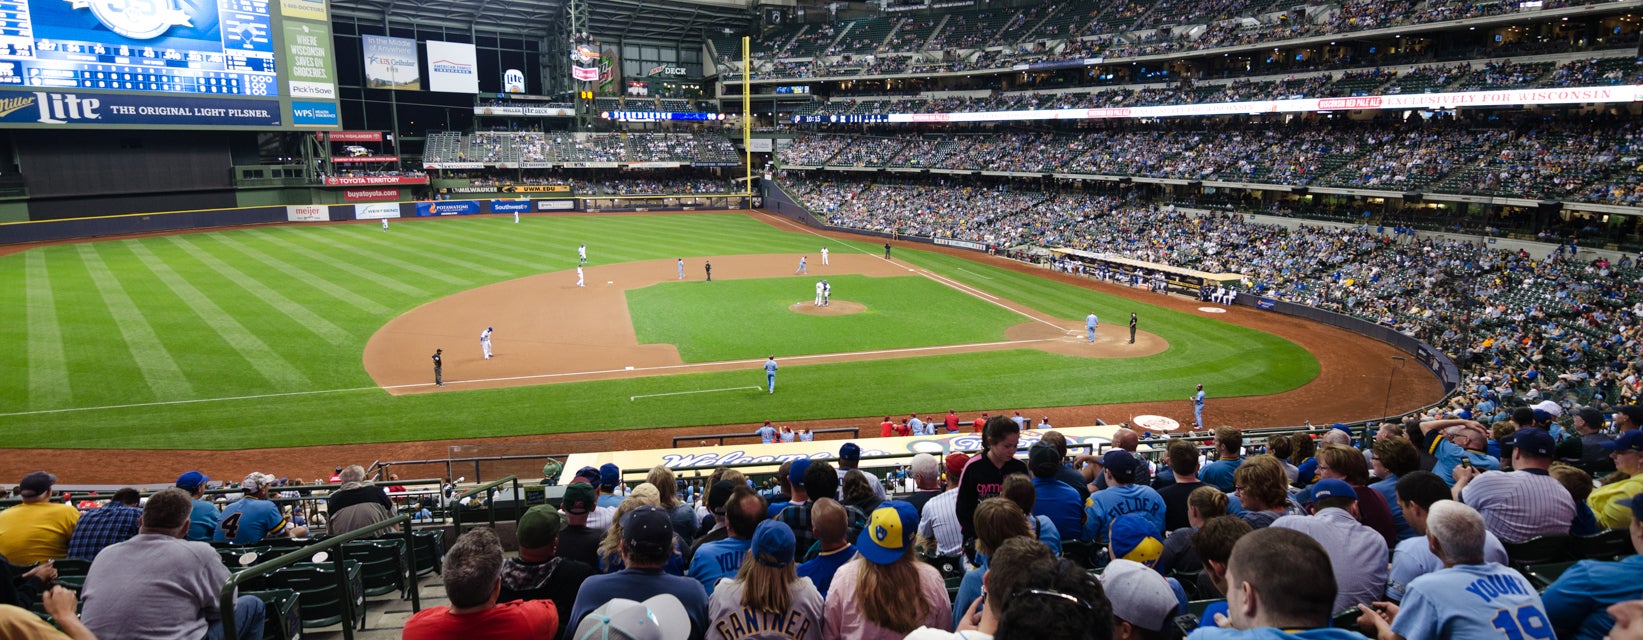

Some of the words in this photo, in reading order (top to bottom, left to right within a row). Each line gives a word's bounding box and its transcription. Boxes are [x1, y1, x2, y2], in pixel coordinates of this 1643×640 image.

[296, 34, 318, 46] WHERE
[290, 44, 325, 57] WISCONSIN
[295, 56, 314, 66] SAVES
[314, 58, 324, 67] ON
[506, 74, 522, 84] Lite
[1319, 100, 1345, 108] WISCONSIN
[1346, 99, 1355, 107] RED
[1356, 98, 1369, 107] PALE
[1370, 98, 1380, 106] ALE
[1387, 95, 1475, 105] EXCLUSIVELY
[1482, 94, 1510, 102] FOR
[1519, 90, 1612, 101] WISCONSIN
[32, 92, 99, 124] Lite
[110, 106, 136, 114] THE
[139, 106, 192, 116] ORIGINAL
[195, 108, 225, 117] LIGHT
[228, 109, 270, 118] PILSNER.
[294, 109, 312, 118] WPS
[521, 107, 534, 115] Lite
[296, 206, 319, 215] meijer
[662, 450, 836, 468] Welcome
[1108, 498, 1160, 518] FIELDER
[221, 512, 242, 539] 4
[716, 606, 810, 640] GANTNER
[1491, 604, 1558, 640] 19
